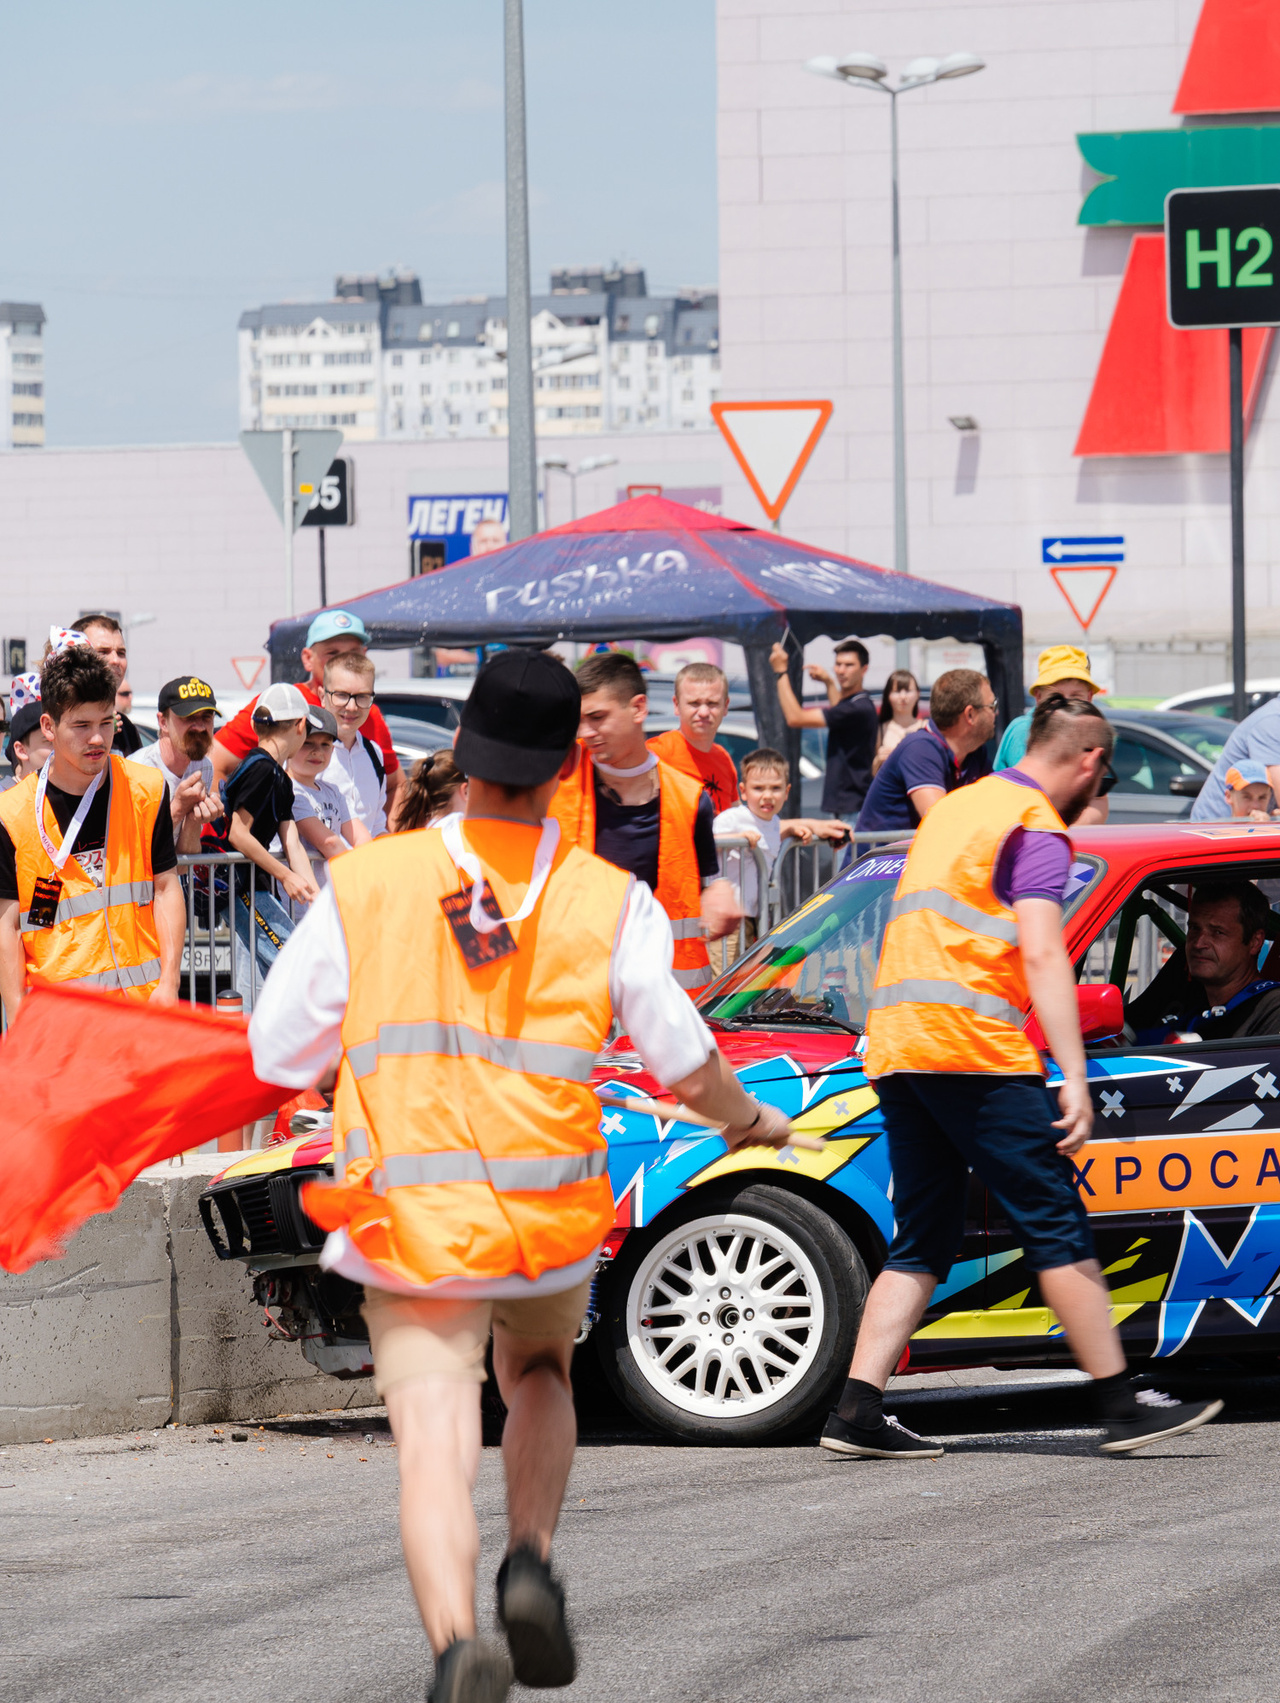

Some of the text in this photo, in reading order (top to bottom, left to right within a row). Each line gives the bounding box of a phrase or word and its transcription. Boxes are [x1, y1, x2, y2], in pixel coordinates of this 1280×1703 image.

[308, 475, 341, 510] 5
[407, 498, 545, 535] ЛЕГЕН
[178, 683, 212, 699] СССР
